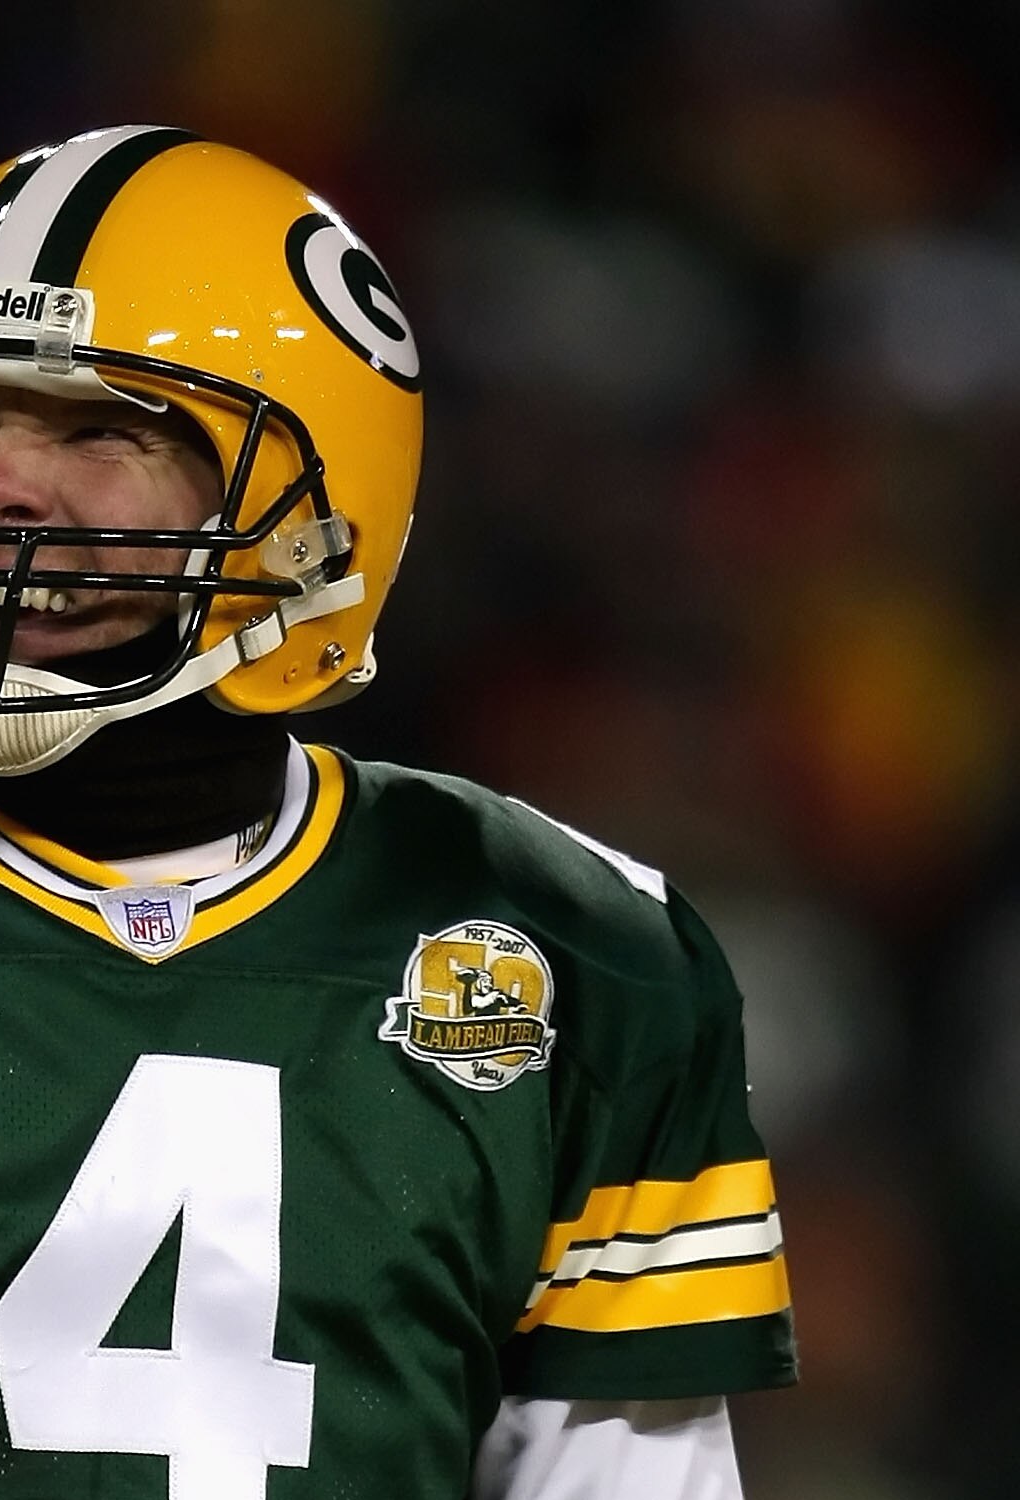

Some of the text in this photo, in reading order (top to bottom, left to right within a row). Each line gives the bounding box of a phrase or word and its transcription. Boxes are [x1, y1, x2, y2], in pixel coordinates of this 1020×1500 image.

[303, 225, 420, 379] G
[131, 917, 172, 942] NFL
[465, 928, 526, 955] 1957-2007
[413, 1021, 541, 1050] LAMBEAU FIELD
